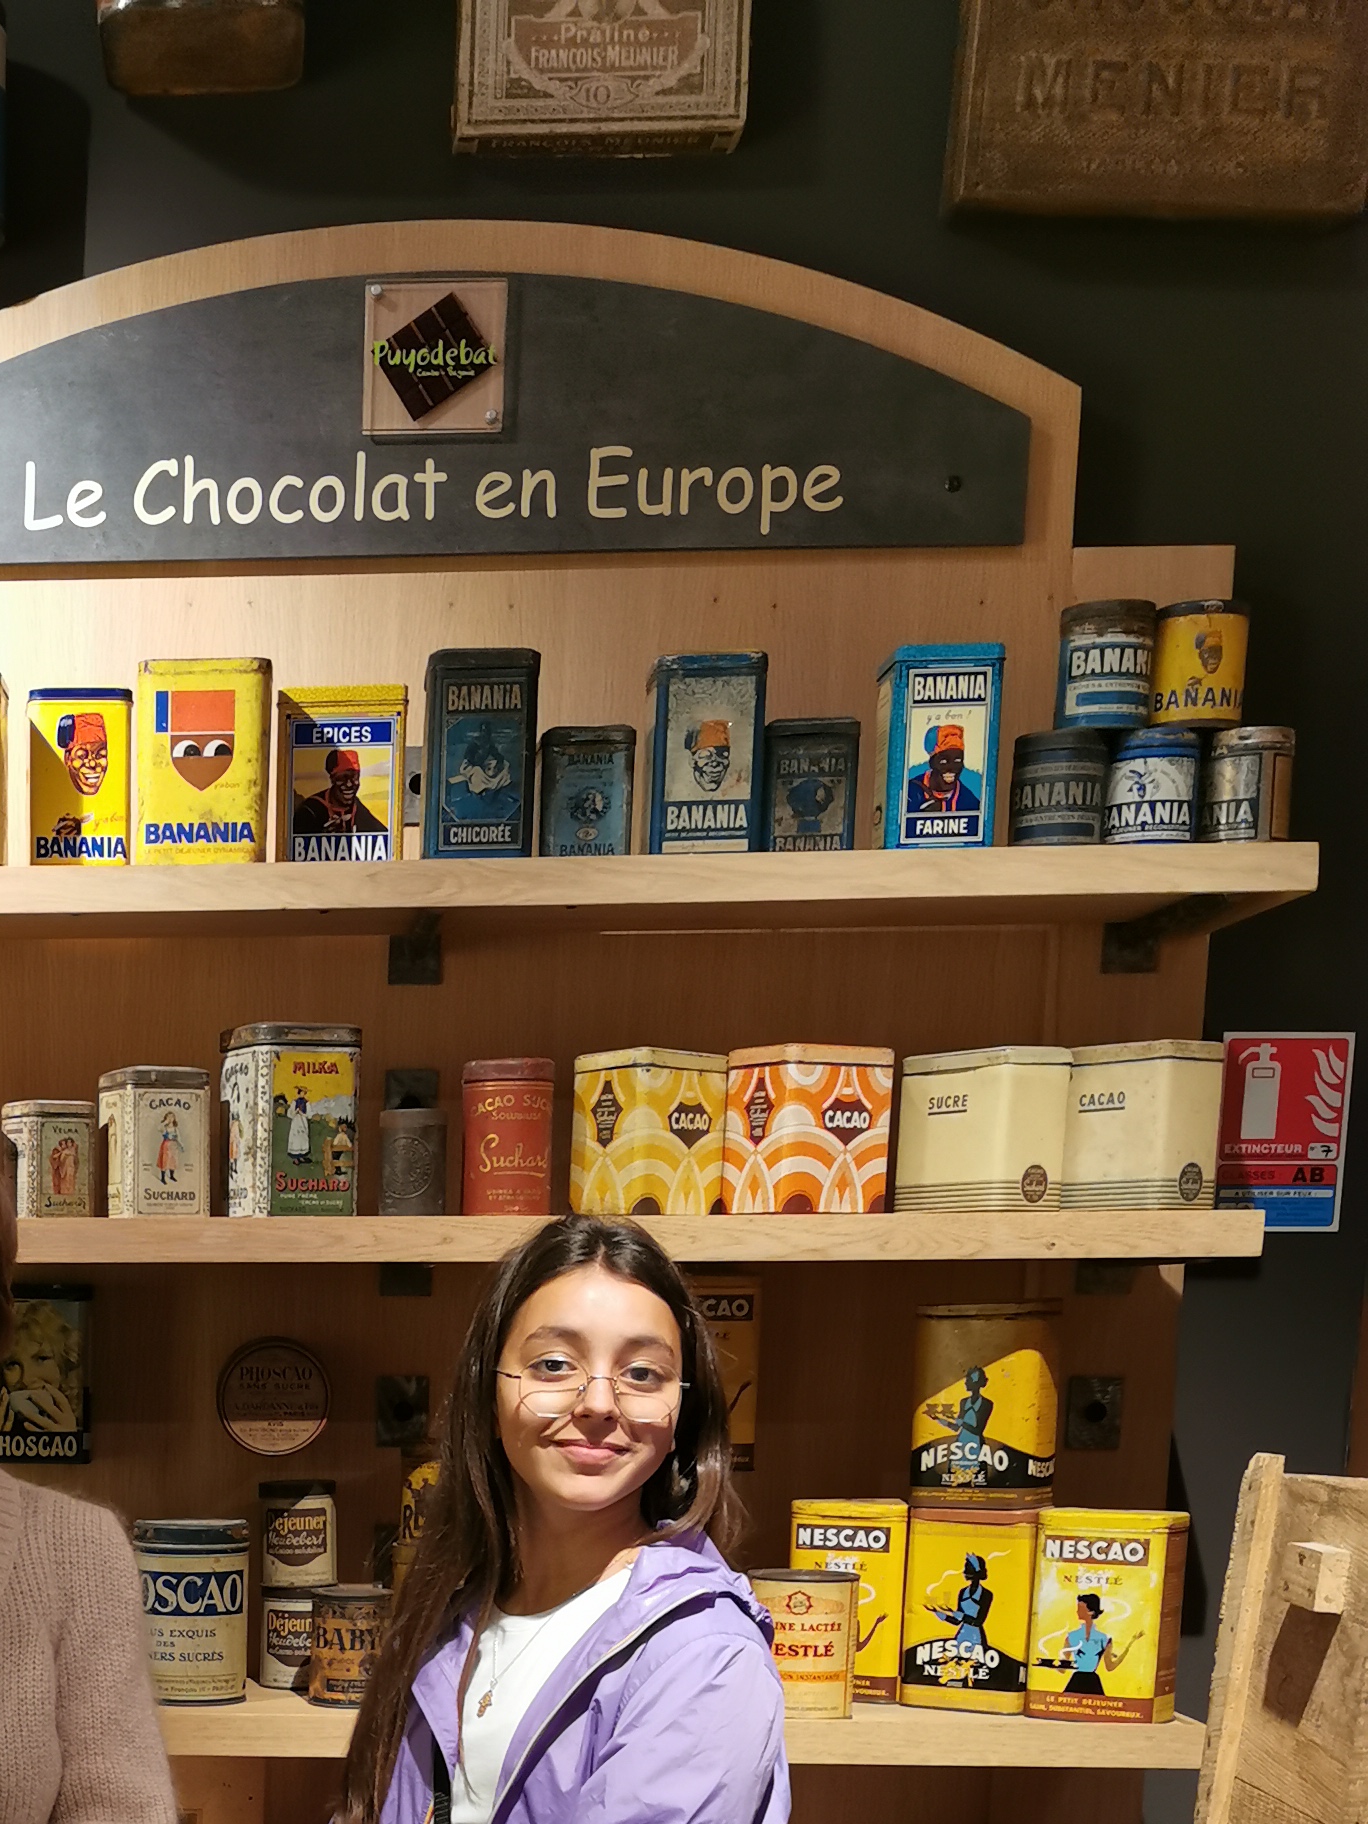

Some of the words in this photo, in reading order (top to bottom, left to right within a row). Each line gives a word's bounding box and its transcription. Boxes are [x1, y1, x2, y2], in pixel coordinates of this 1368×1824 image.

[560, 23, 650, 45] Praline
[373, 339, 497, 373] Puyodebat
[24, 462, 108, 531] Le
[133, 451, 448, 525] Chocolat
[475, 467, 557, 520] en
[589, 446, 844, 535] Europe
[448, 684, 522, 711] BANANIA
[913, 675, 986, 702] BANANIA
[312, 721, 372, 745] ÉPICES
[667, 804, 747, 830] BANANIA
[915, 818, 968, 836] FARINE
[145, 822, 256, 846] BANANIA
[450, 823, 512, 844] CHICORÉE
[36, 836, 127, 860] BANANIA
[294, 836, 389, 862] BANANIA
[559, 843, 615, 856] BANANIA
[292, 1060, 340, 1077] MILKA
[149, 1097, 191, 1111] CACAO
[470, 1094, 515, 1117] CACAO
[927, 1094, 969, 1110] SUCRE
[1078, 1091, 1126, 1108] CACAO
[52, 1125, 79, 1135] VELMA
[671, 1112, 710, 1131] CACAO
[824, 1110, 871, 1130] CACAO
[1224, 1143, 1302, 1154] EXTINCTEUR
[1321, 1144, 1333, 1157] 7
[275, 1171, 350, 1192] SUCHARD
[1292, 1167, 1325, 1182] AB
[143, 1188, 196, 1201] SUCHARD
[239, 1366, 312, 1381] PHOSCAO
[274, 1382, 311, 1390] SUCRE
[920, 1441, 1009, 1472] NESCAO
[798, 1528, 886, 1549] NESCAO
[1045, 1538, 1145, 1563] NESCAO
[814, 1560, 868, 1571] NESTLÉ
[1062, 1571, 1124, 1586] NESTLÉ
[140, 1573, 242, 1614] OSCAO
[169, 1628, 217, 1640] EXQUIS
[316, 1626, 382, 1651] BABY
[774, 1641, 835, 1657] ESTLÉ
[916, 1640, 1000, 1669] NESCAO
[922, 1664, 990, 1680] NESTLÉ
[1058, 1696, 1078, 1704] PETIT
